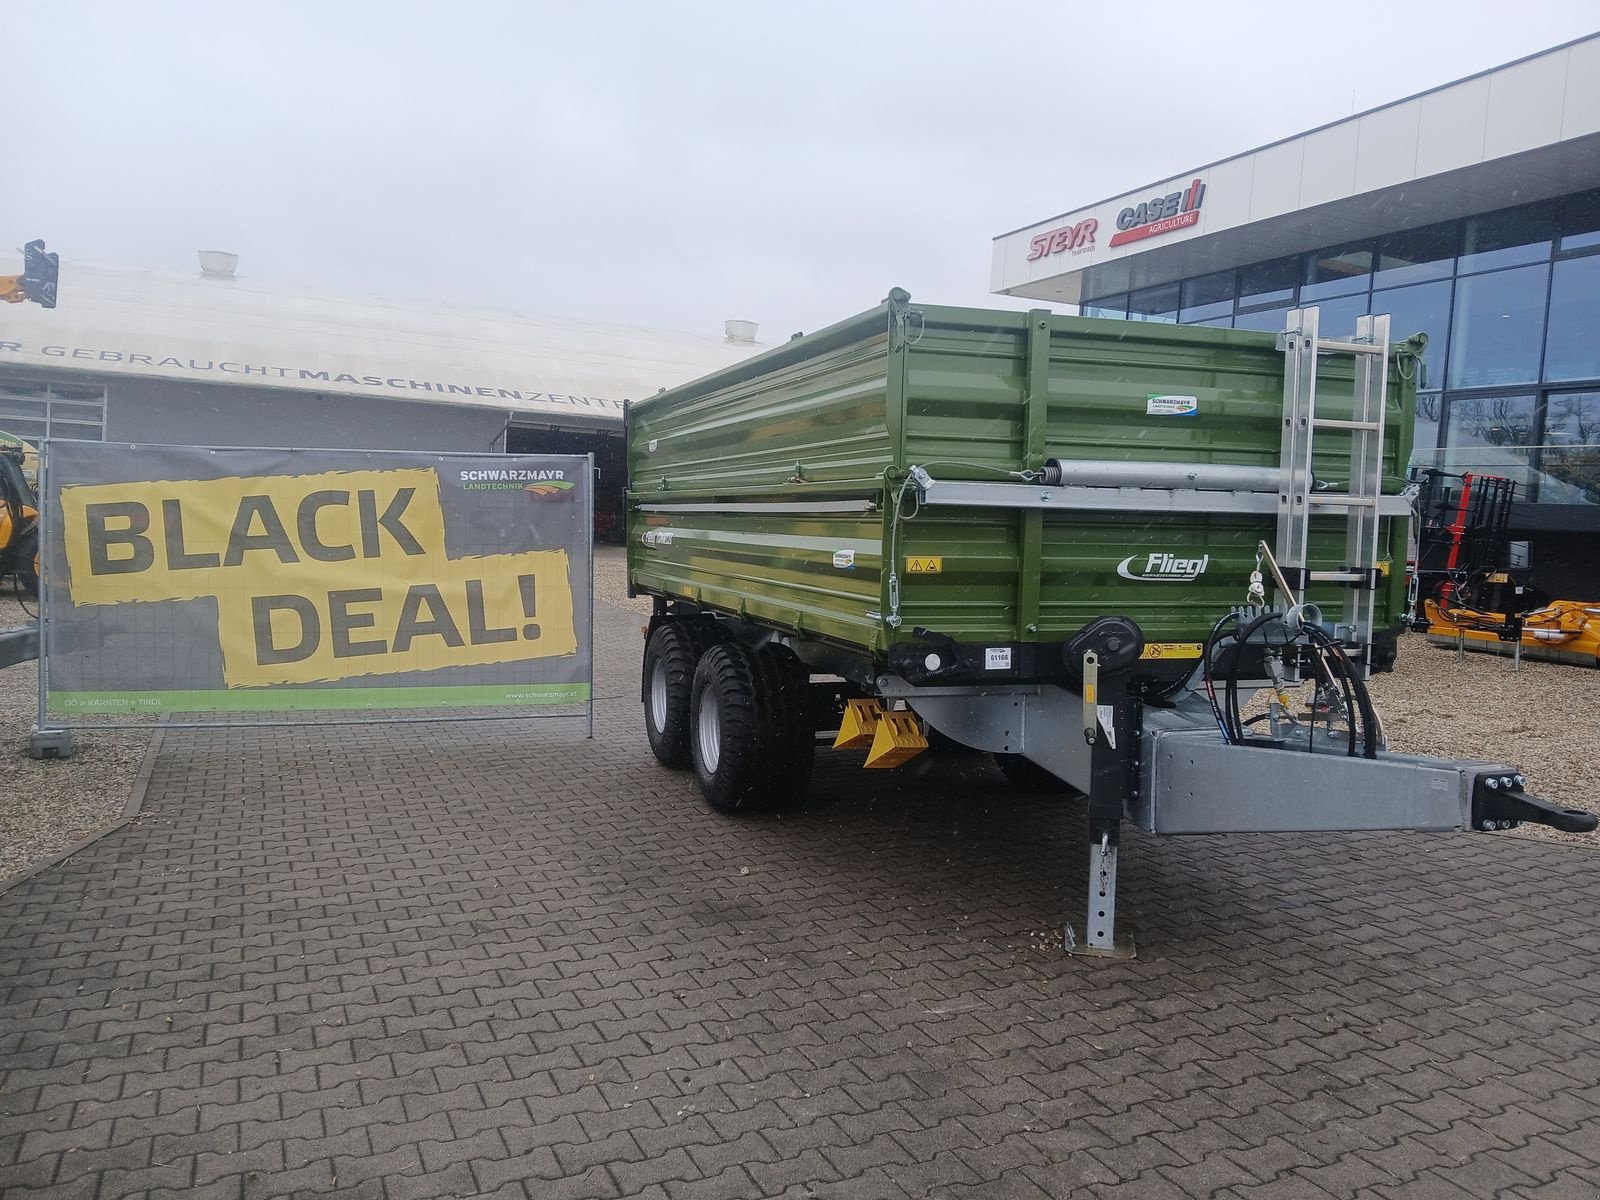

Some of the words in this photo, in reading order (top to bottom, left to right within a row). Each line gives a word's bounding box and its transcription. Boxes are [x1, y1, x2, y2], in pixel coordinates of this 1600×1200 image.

[1149, 213, 1195, 234] AGRICULTURE
[1027, 218, 1099, 261] STEYR
[460, 470, 564, 481] SCHWARZMAYR
[463, 482, 524, 490] LANDTECHNIK
[85, 487, 426, 576] BLACK
[1144, 553, 1209, 578] Fliegl
[251, 574, 542, 666] DEAL!
[138, 698, 162, 706] TIROL
[504, 691, 577, 699] www.schwarzmayr.at
